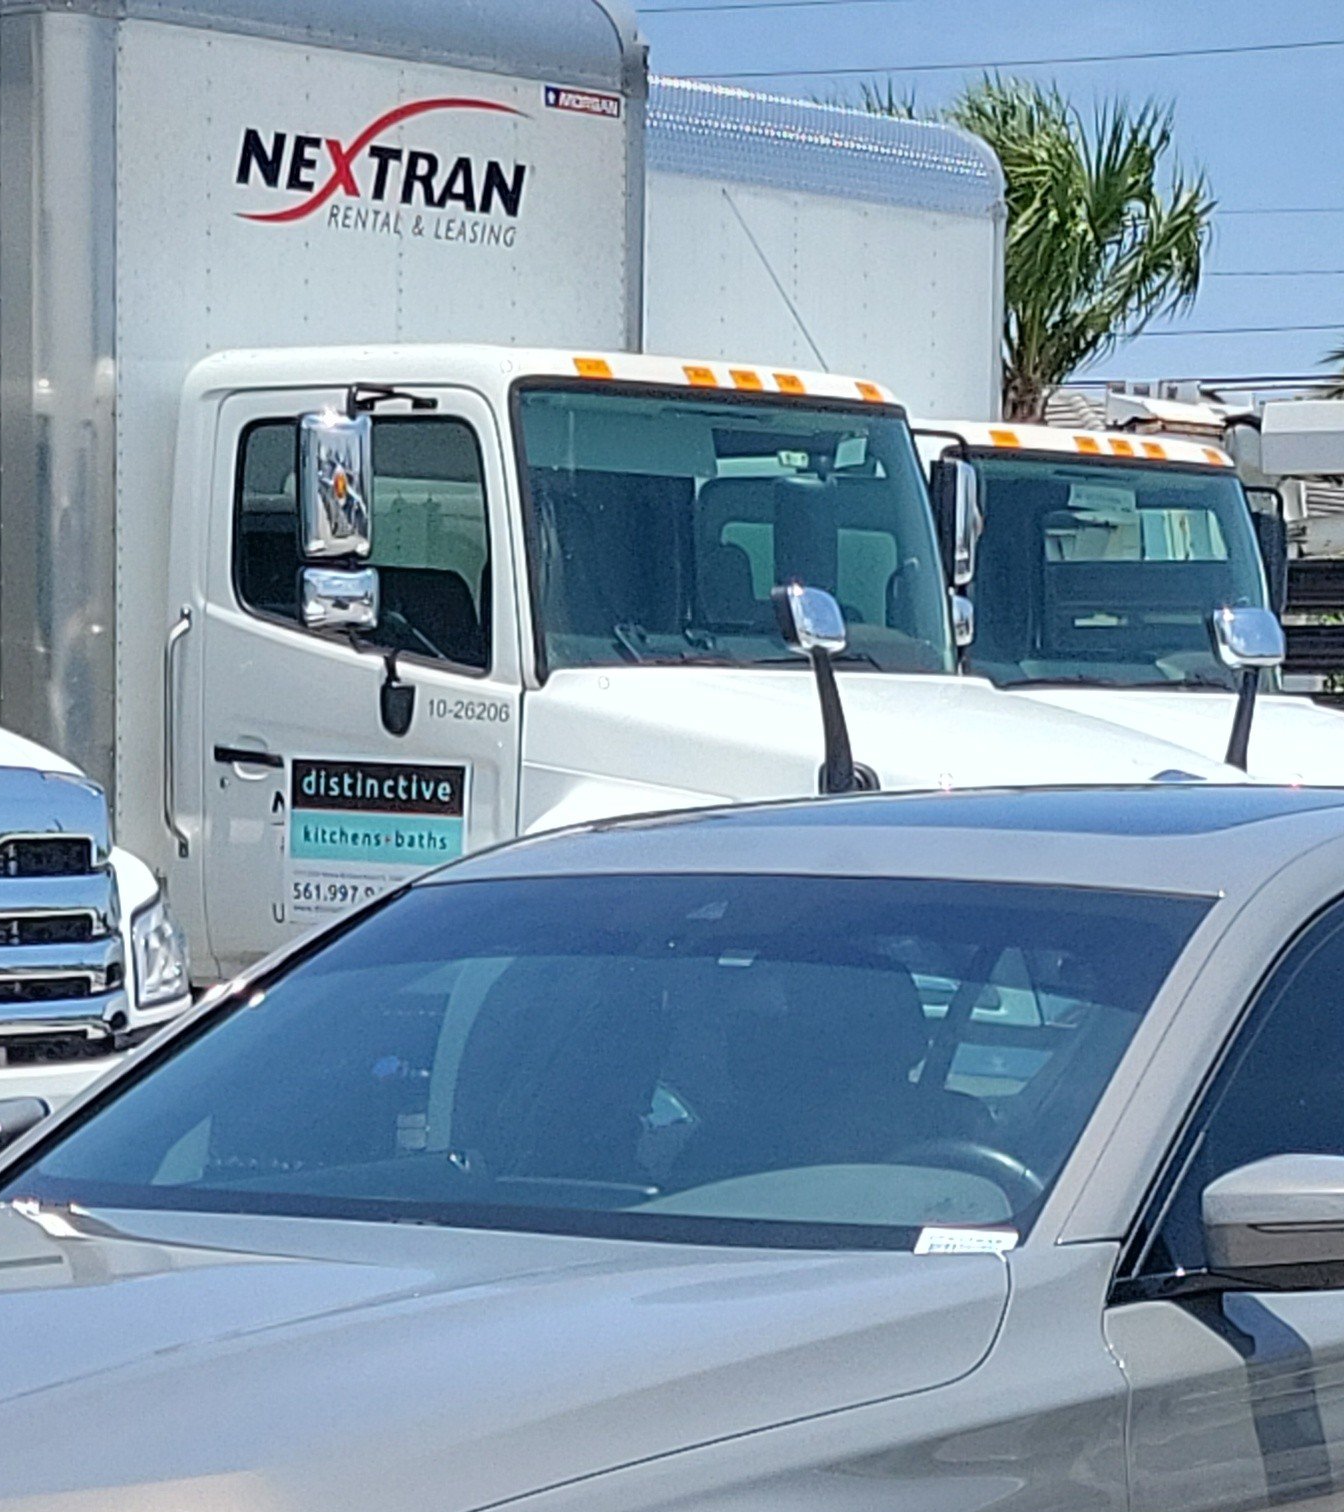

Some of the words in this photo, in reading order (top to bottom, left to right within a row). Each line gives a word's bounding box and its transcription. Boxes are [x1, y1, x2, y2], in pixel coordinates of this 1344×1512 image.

[559, 91, 618, 115] MORGAN
[236, 126, 527, 218] NEXTRAN
[327, 205, 402, 235] RENTAL
[412, 215, 424, 237] &
[434, 216, 517, 248] LEASING
[428, 699, 510, 723] 10-26206
[302, 769, 453, 802] distinctive
[303, 825, 381, 846] kitchens
[395, 829, 447, 850] baths
